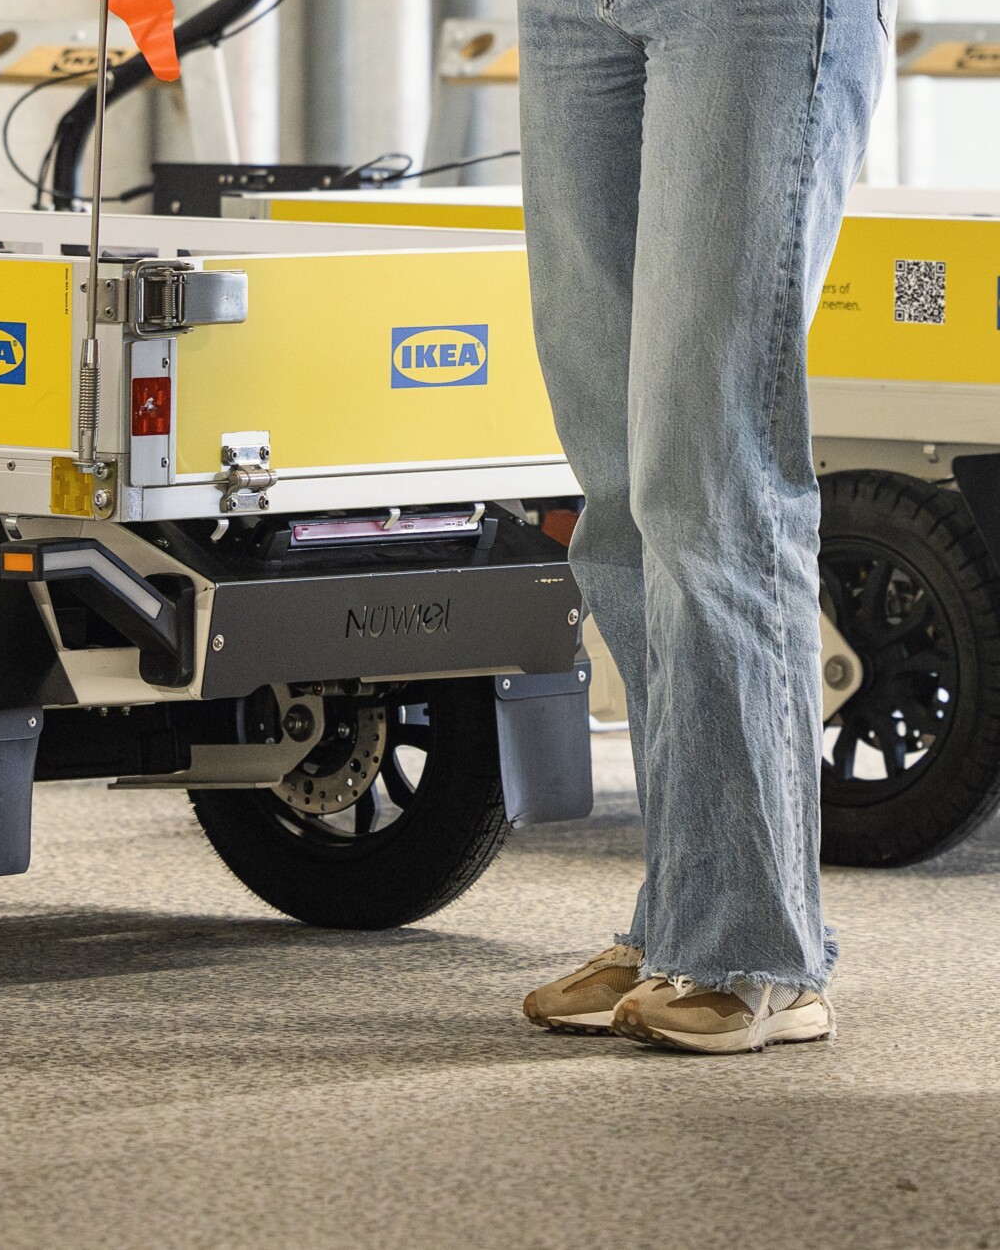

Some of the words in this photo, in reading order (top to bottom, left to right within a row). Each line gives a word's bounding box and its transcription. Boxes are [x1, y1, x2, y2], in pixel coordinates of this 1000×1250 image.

[839, 283, 851, 294] of
[822, 301, 862, 311] nemen.
[401, 343, 480, 369] IKEA
